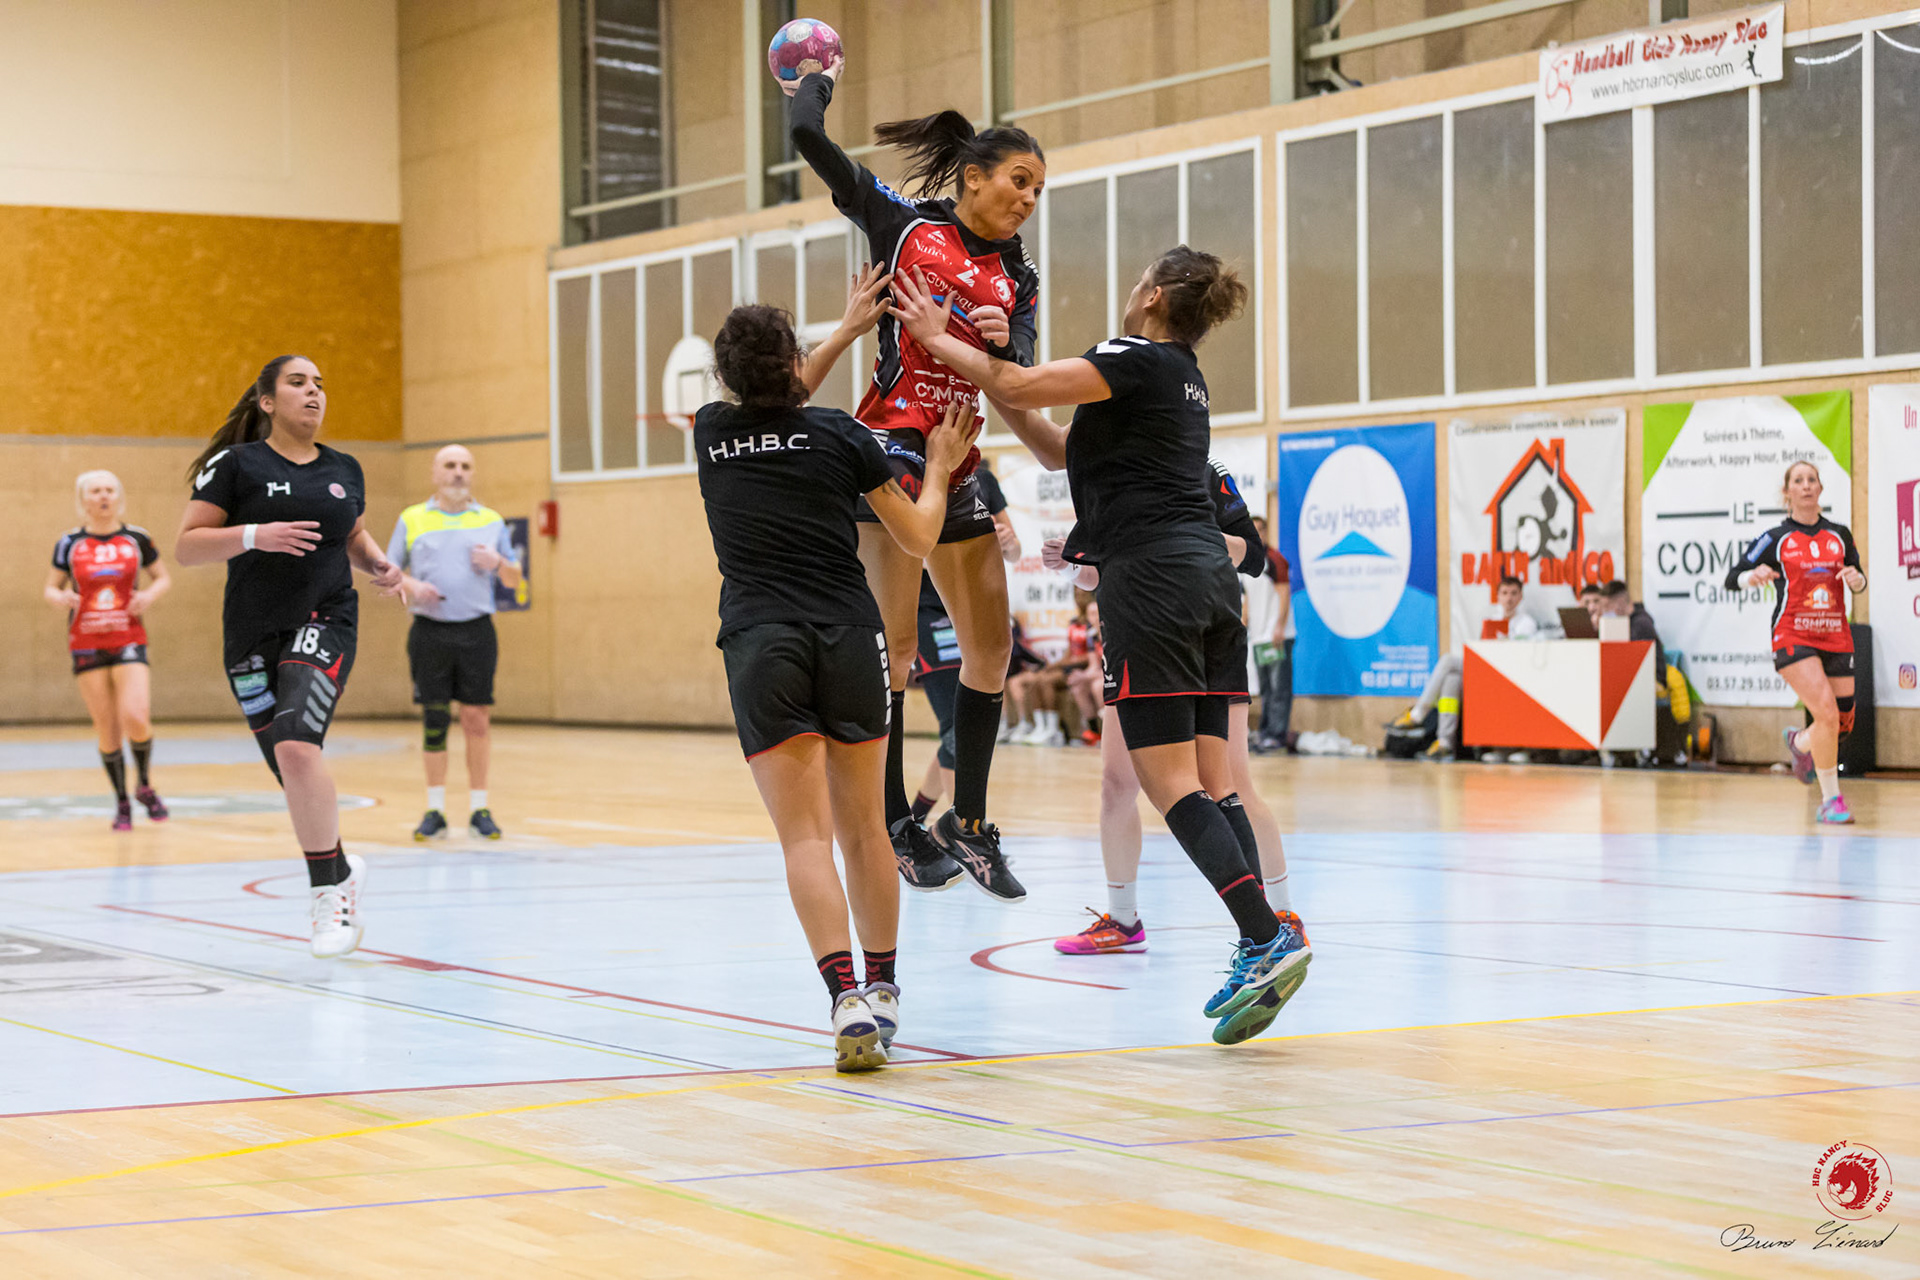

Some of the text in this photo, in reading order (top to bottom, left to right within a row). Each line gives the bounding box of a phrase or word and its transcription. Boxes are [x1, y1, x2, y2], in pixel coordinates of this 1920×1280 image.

[1573, 40, 1634, 75] Handball
[1733, 18, 1767, 44] Sluc
[1591, 62, 1734, 99] www.hbcnancysluc.com
[956, 258, 980, 288] 2
[1904, 405, 1917, 429] Un
[708, 433, 811, 462] H.H.B.C.
[1719, 451, 1750, 466] Happy
[1306, 503, 1400, 535] Guy Hoquet
[1733, 502, 1755, 524] LE
[291, 626, 320, 655] 18
